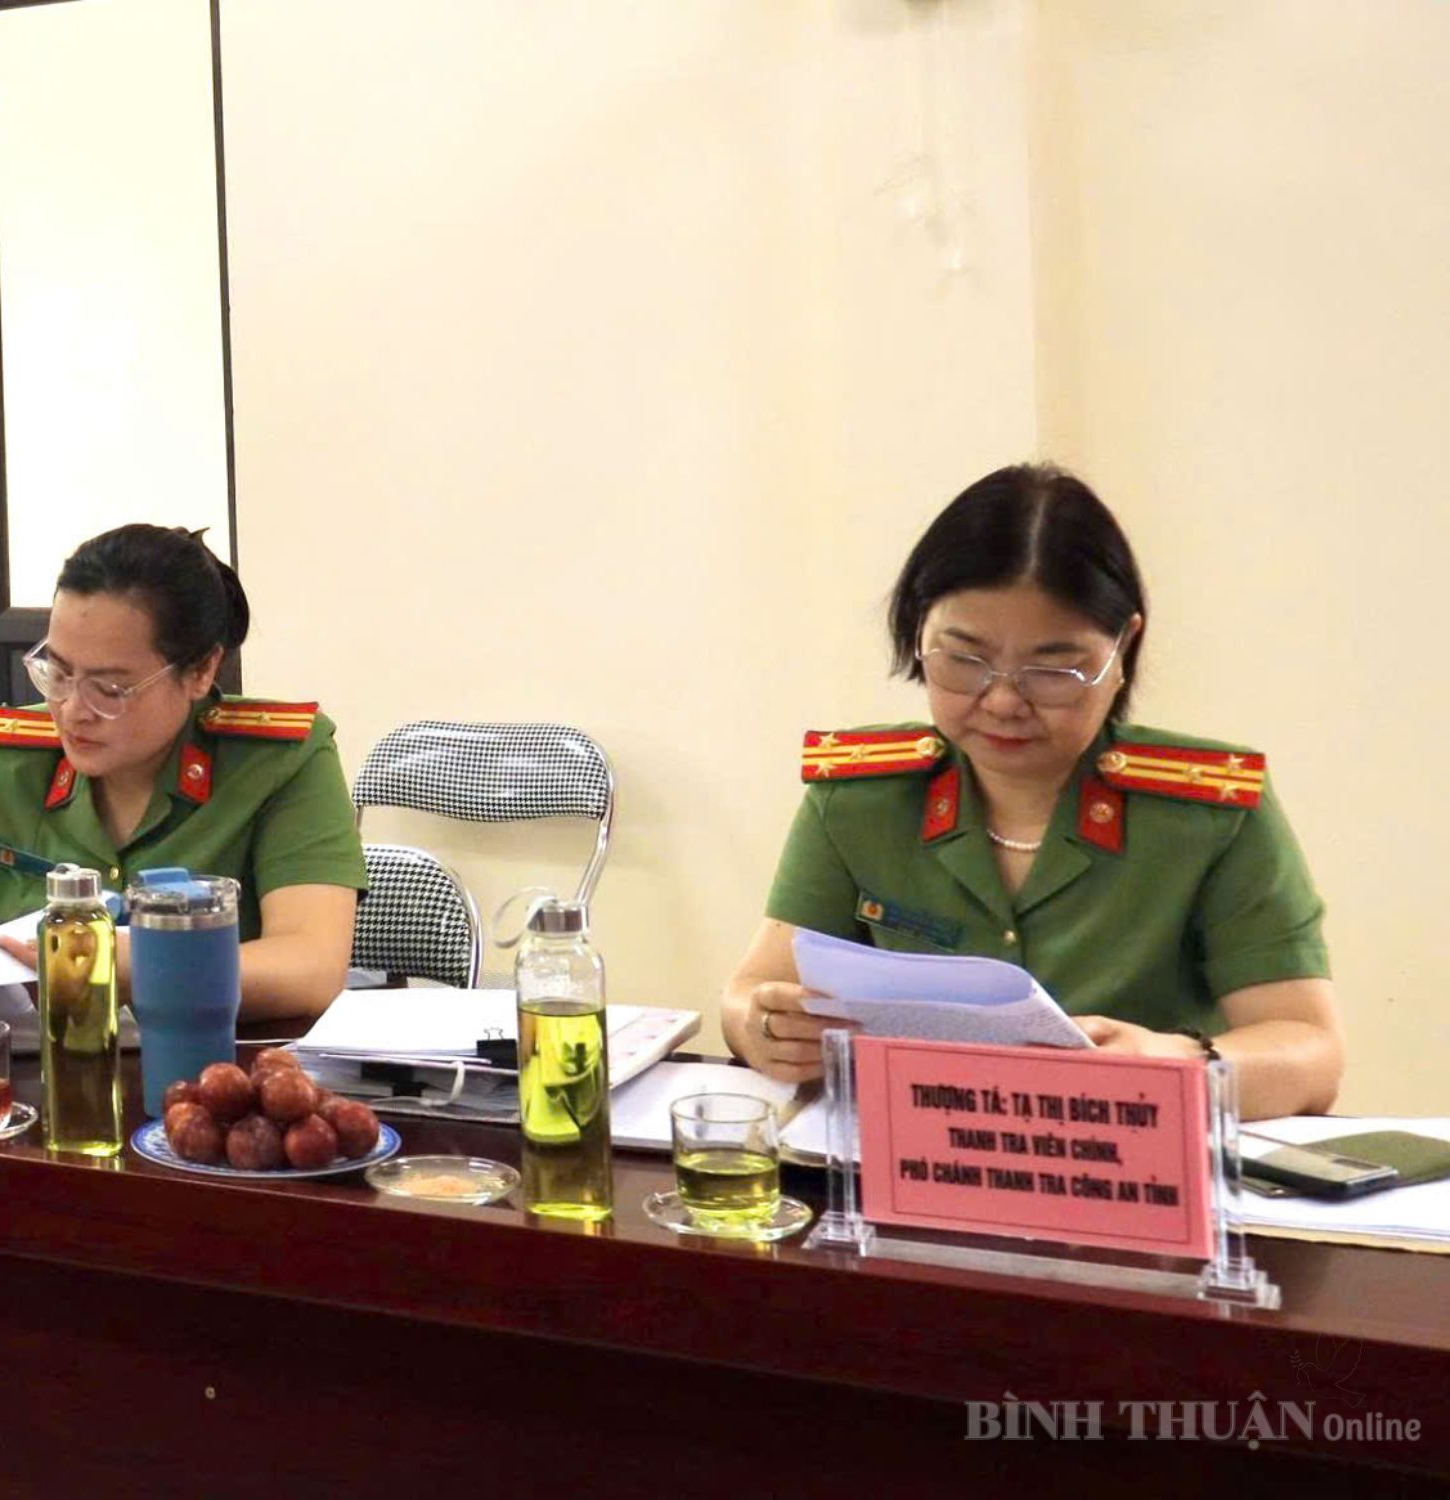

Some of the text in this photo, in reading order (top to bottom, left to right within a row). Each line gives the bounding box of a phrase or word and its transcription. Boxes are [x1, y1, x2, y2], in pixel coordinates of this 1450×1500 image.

[911, 1084, 976, 1115] THƯỢNG
[981, 1086, 1007, 1115] TÁ:
[1012, 1092, 1033, 1123] TẠ
[1037, 1094, 1064, 1125] THỊ
[1070, 1092, 1110, 1124] BÍCH
[948, 1127, 997, 1151] THANH
[1001, 1132, 1028, 1154] TRA
[1032, 1132, 1066, 1158] VIÊN
[900, 1157, 1179, 1207] PHÓ CHÁNH THANH TRA CÔNG AN TỈNH
